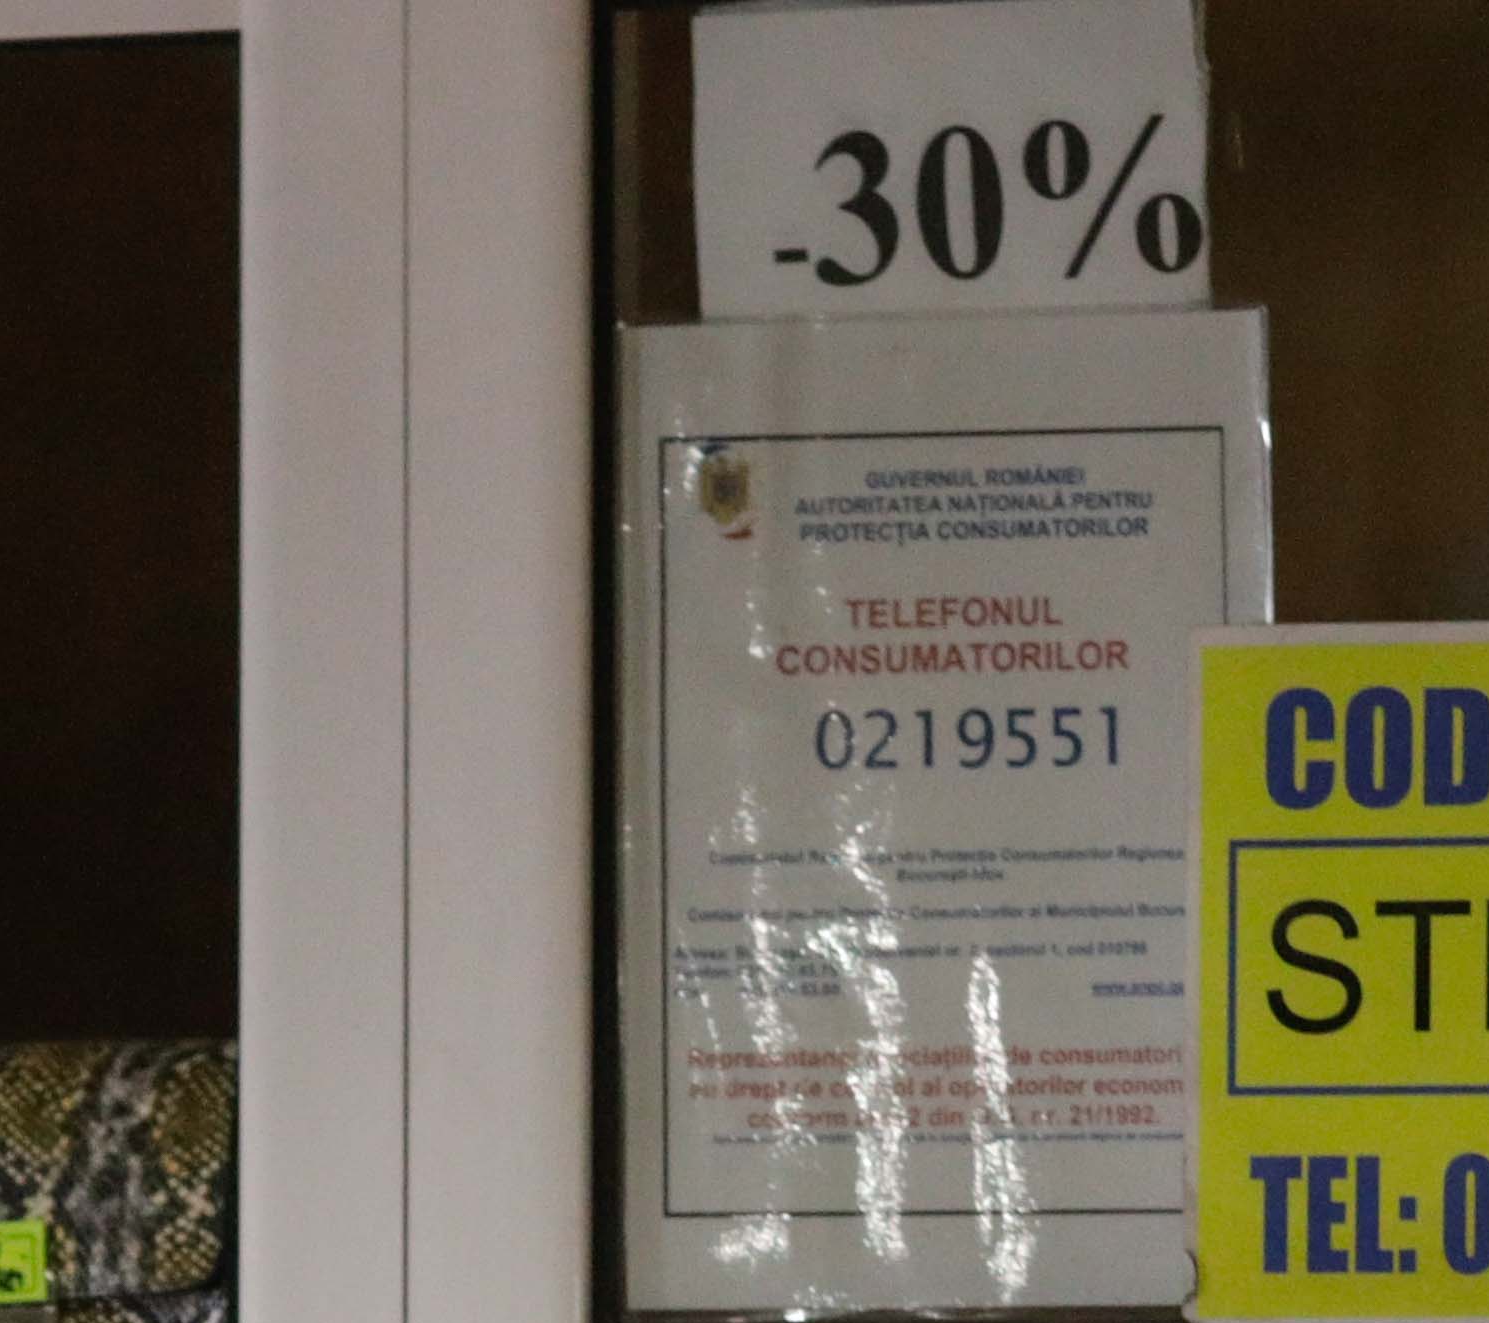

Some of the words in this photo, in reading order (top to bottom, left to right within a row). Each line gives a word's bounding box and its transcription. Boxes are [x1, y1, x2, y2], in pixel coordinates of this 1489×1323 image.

[773, 112, 1204, 287] -30%
[865, 470, 979, 490] GUVERNUL
[794, 495, 942, 515] AUTORITATEA
[1071, 490, 1154, 512] PENTRU
[937, 516, 1150, 541] CONSUMATORILOR
[845, 596, 1064, 630] TELEFONUL
[775, 640, 1130, 677] CONSUMATORILOR
[814, 704, 1122, 770] 0219551
[1248, 1153, 1417, 1277] TEL:
